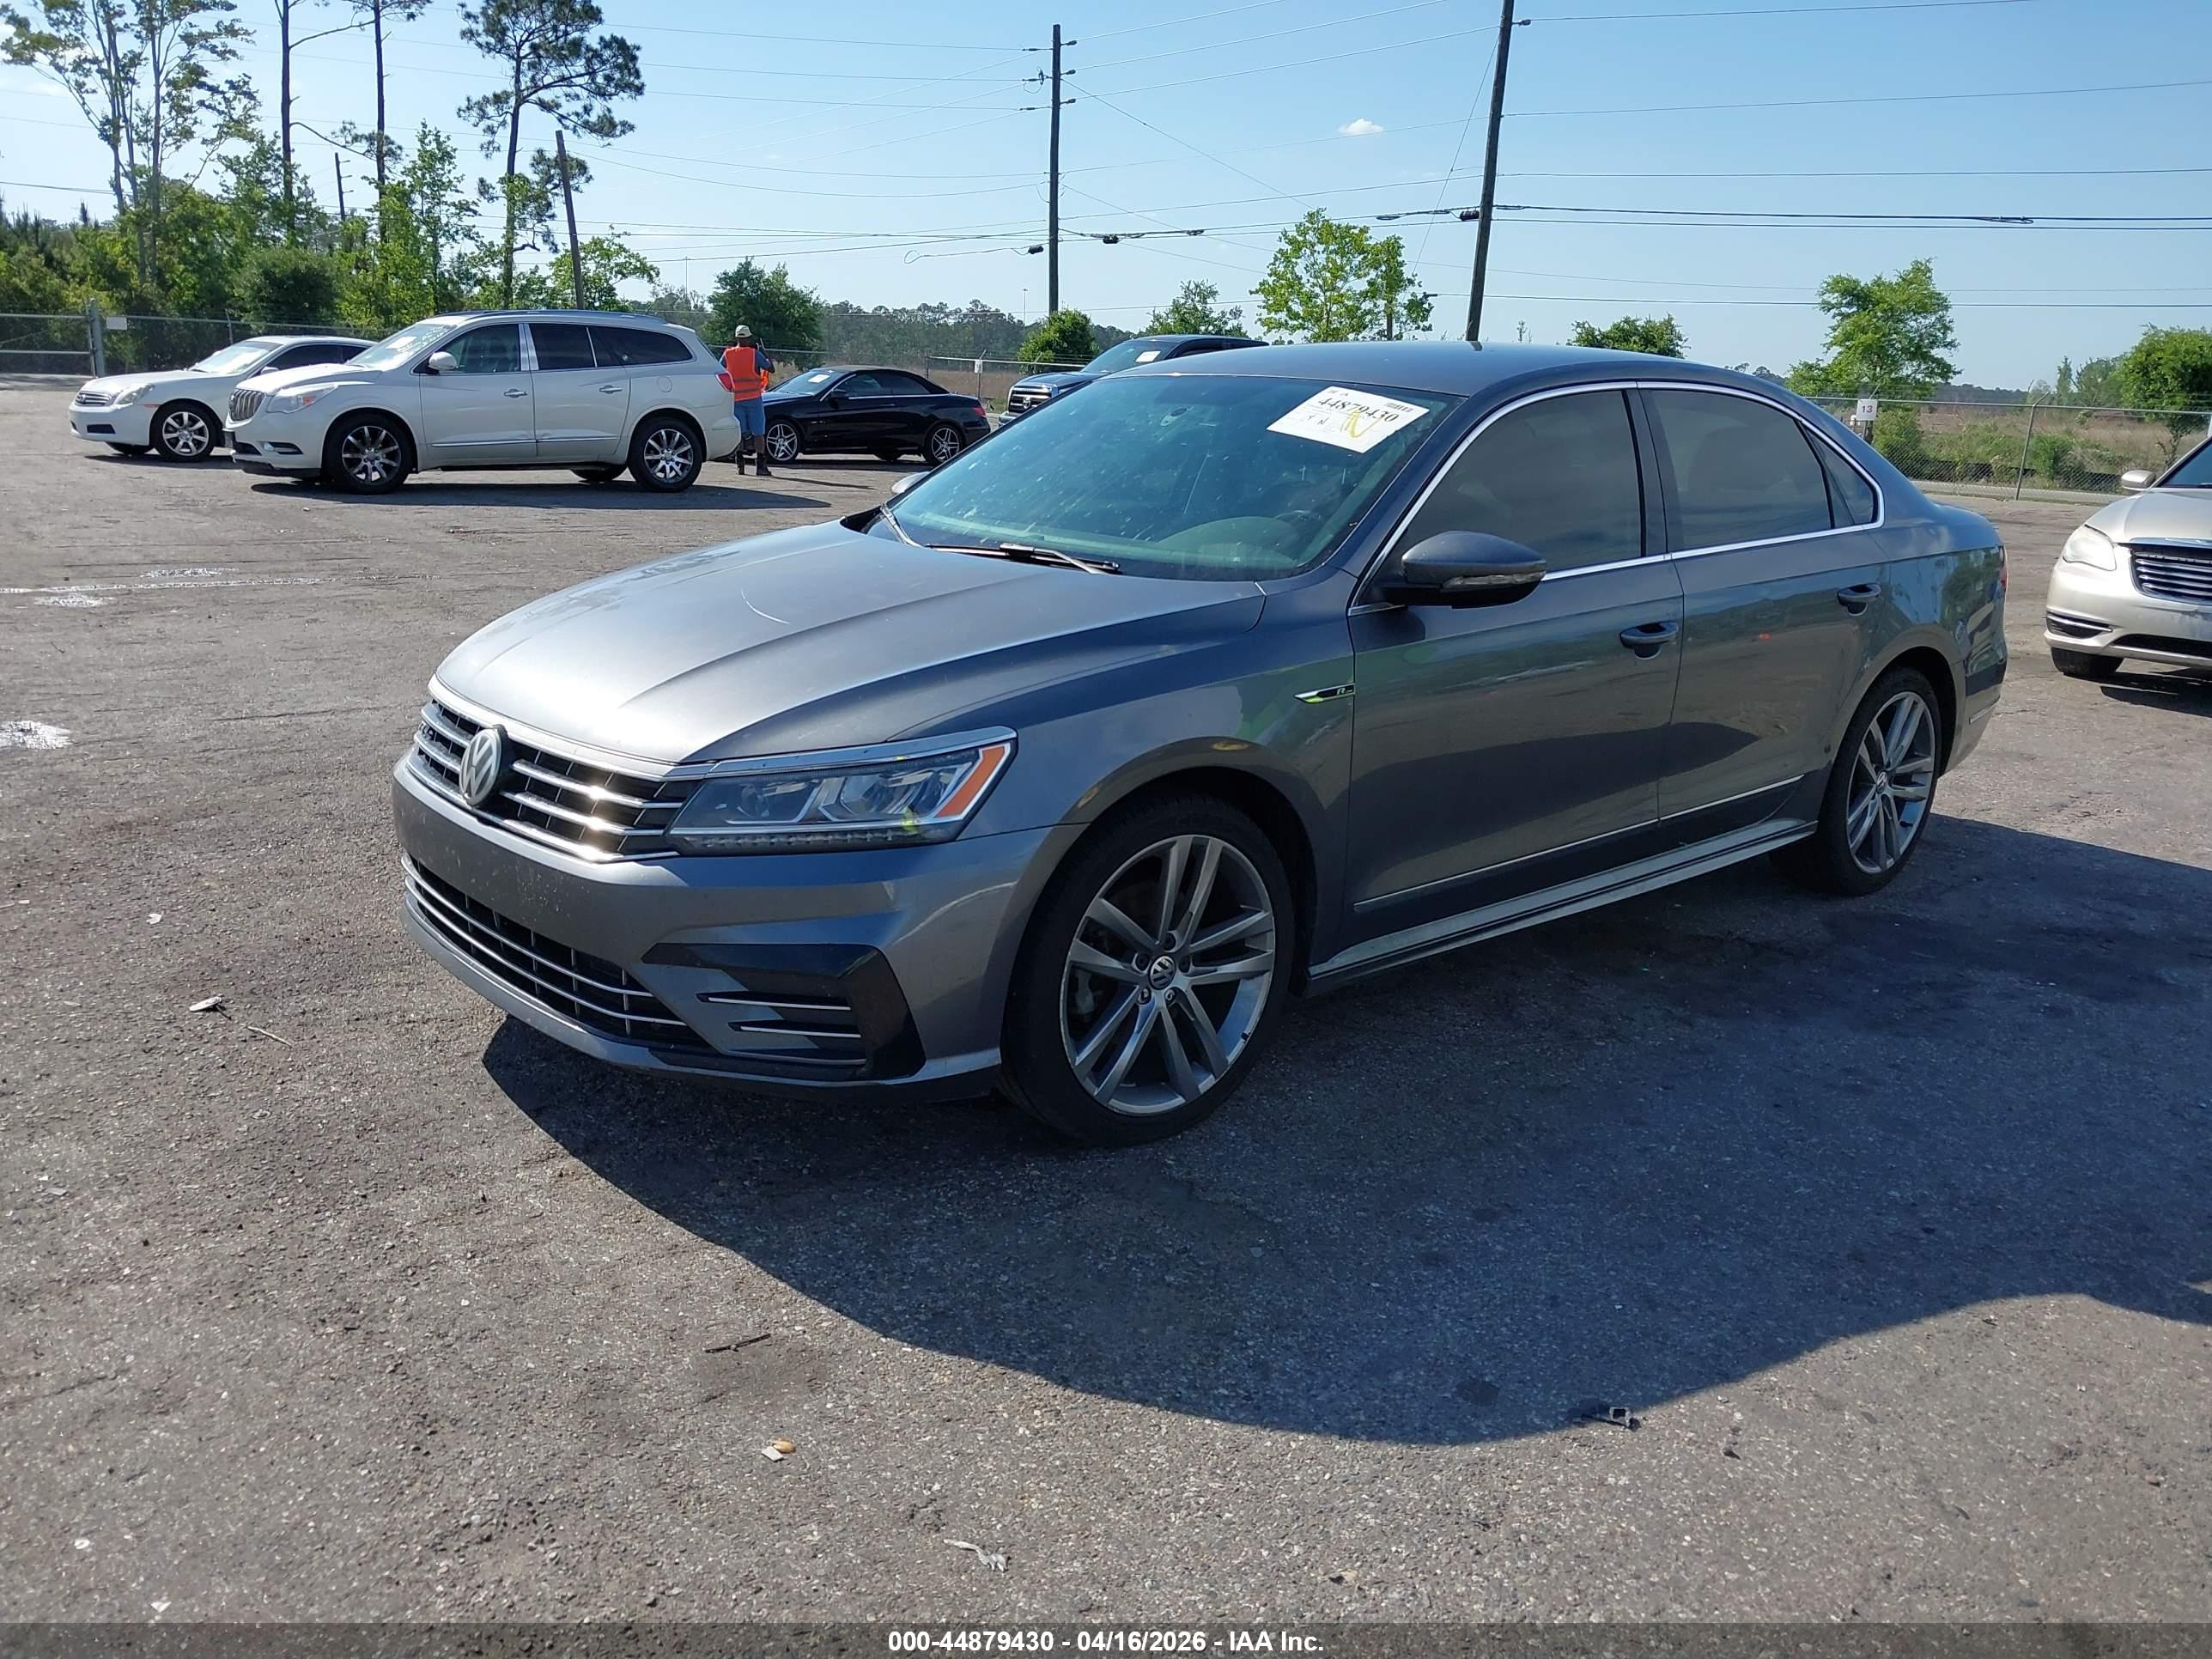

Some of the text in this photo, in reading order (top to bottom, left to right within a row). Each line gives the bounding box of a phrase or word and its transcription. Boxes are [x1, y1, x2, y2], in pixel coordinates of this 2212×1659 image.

[1318, 398, 1400, 422] 44879430
[1861, 404, 1873, 413] 13
[459, 728, 501, 805] VW
